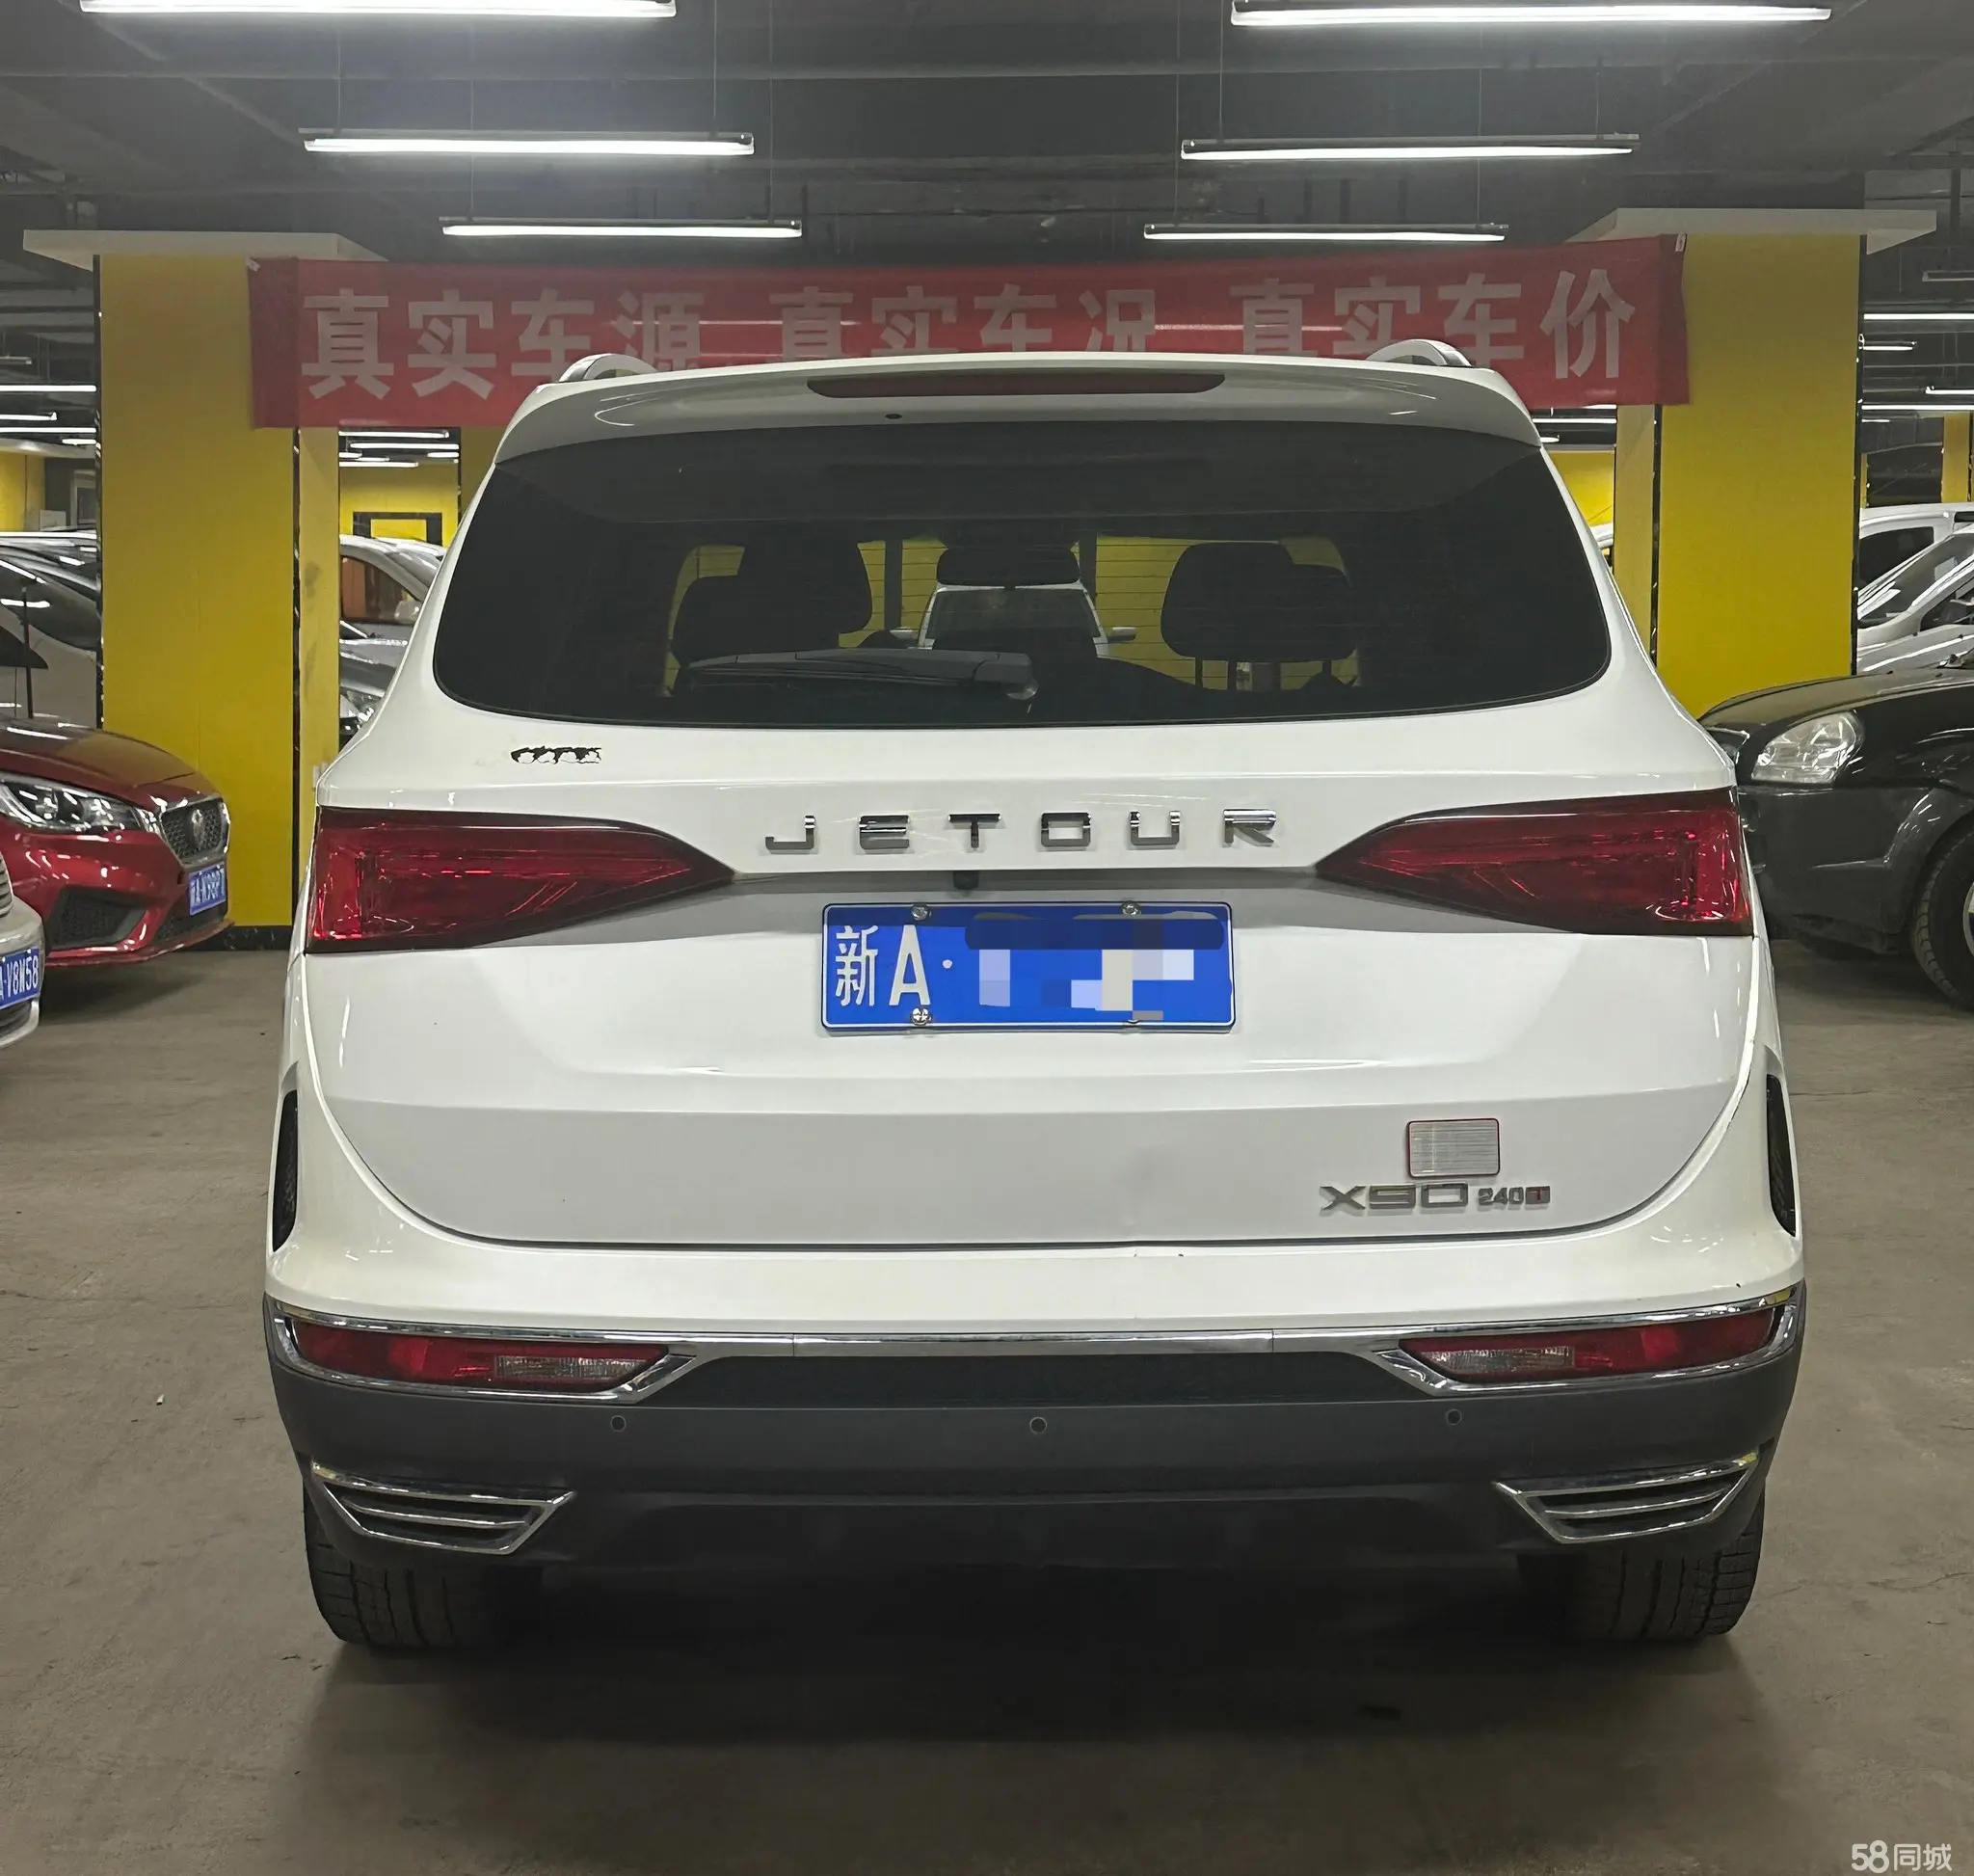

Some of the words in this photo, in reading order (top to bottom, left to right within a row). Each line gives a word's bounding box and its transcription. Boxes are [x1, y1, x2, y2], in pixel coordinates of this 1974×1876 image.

[301, 288, 706, 400] 真实车源
[769, 283, 1156, 362] 真实车况
[1230, 269, 1636, 379] 真实车价
[765, 808, 1277, 850] JETOUR
[1319, 1182, 1469, 1211] X90
[1477, 1186, 1550, 1206] 240T
